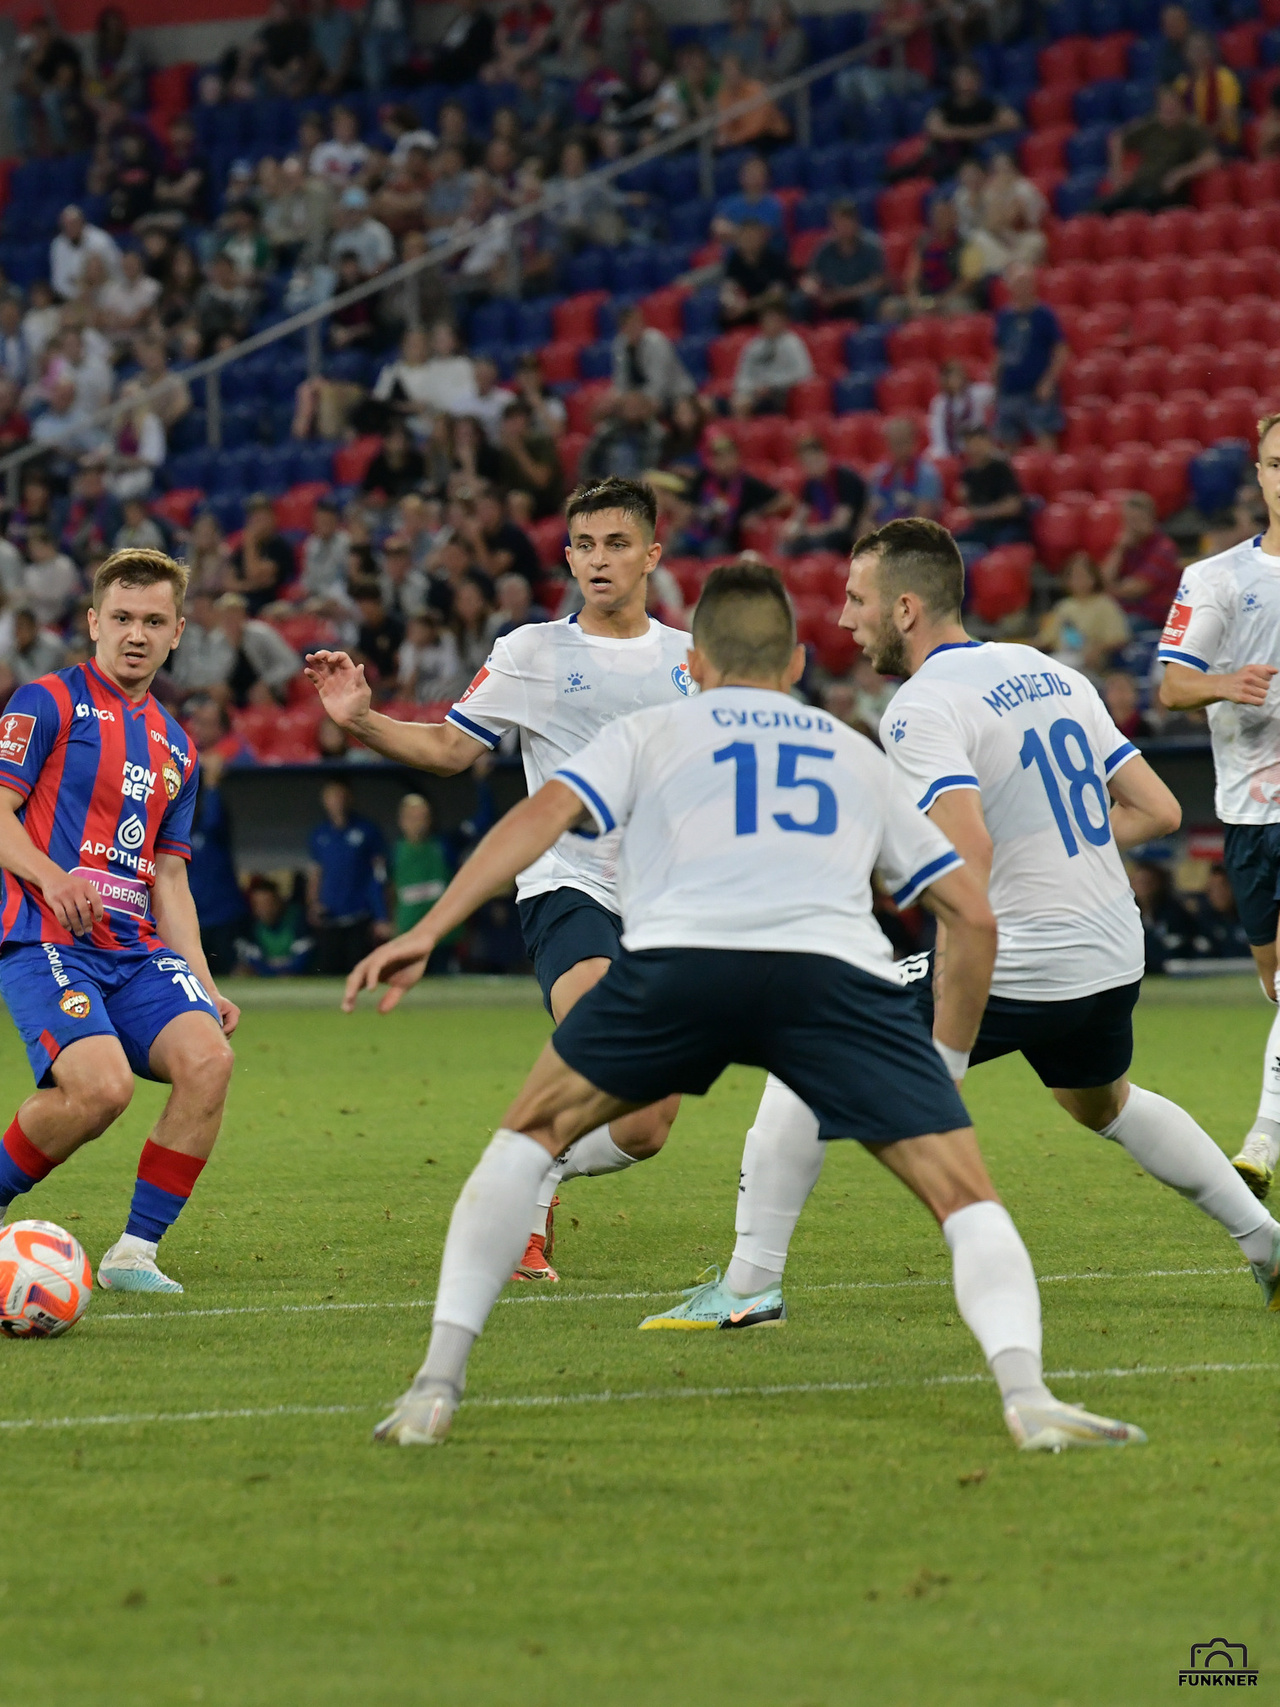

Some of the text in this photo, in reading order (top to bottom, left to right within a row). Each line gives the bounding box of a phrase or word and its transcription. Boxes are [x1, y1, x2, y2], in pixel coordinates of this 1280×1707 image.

[564, 684, 591, 694] KELME
[982, 672, 1072, 718] МЕНДЕЛЬ
[712, 708, 834, 734] СУСЛОВ
[121, 777, 155, 804] BET
[122, 760, 157, 788] FON
[713, 741, 839, 837] 15
[1019, 718, 1111, 858] 18
[80, 839, 156, 877] APOTHEK
[172, 972, 214, 1007] 10
